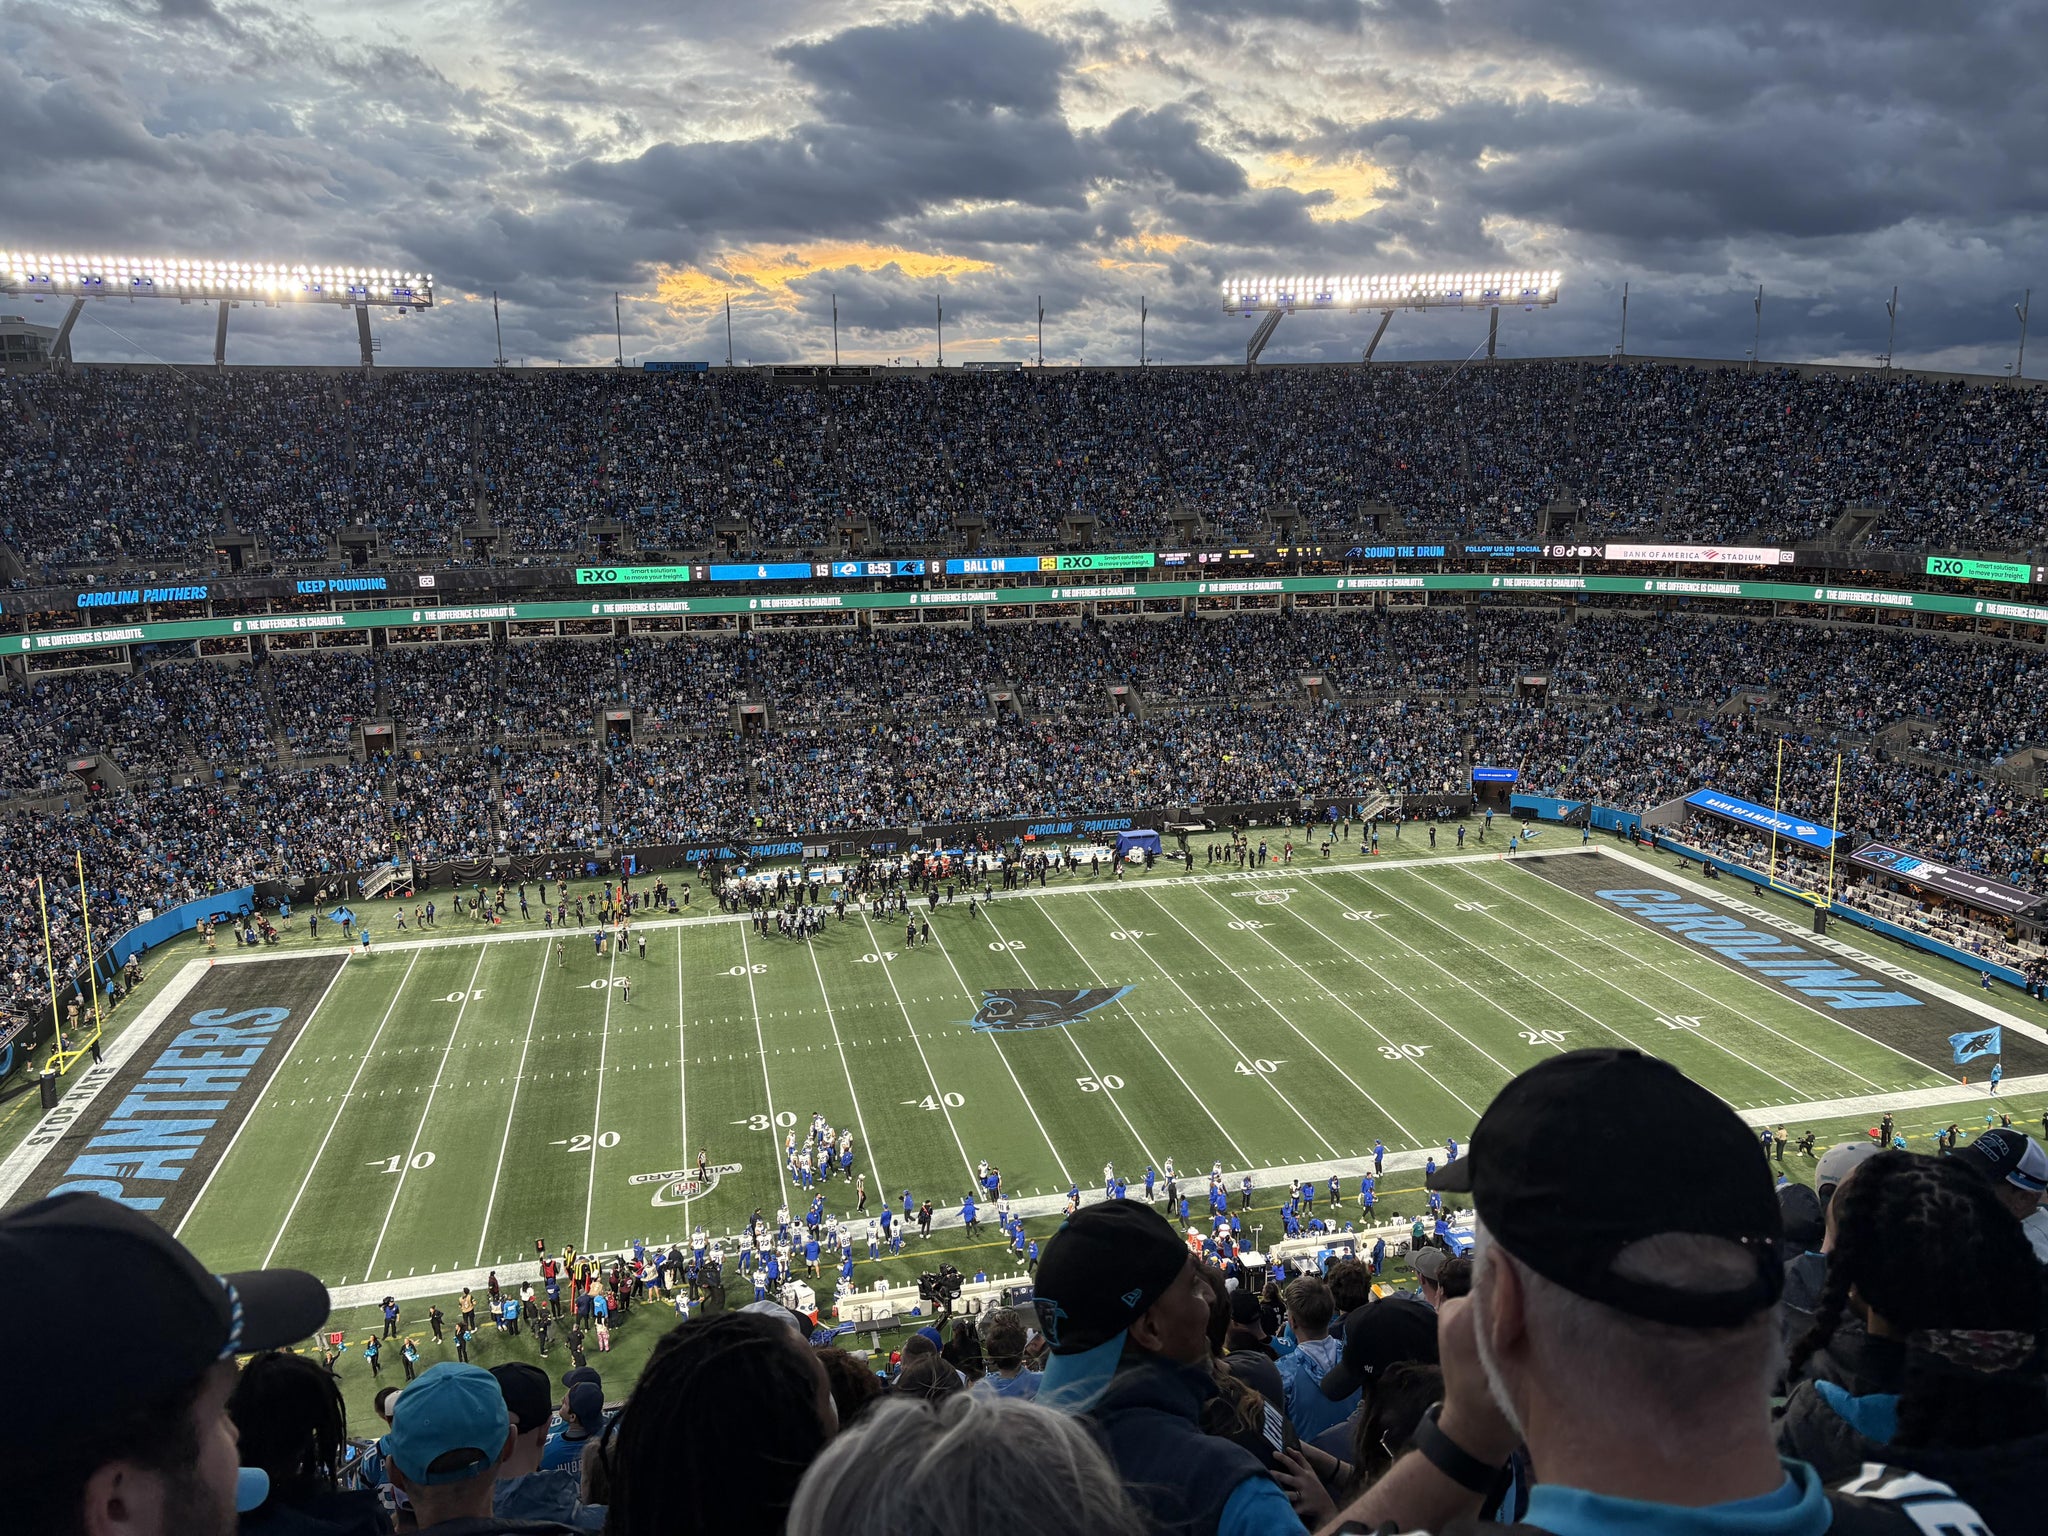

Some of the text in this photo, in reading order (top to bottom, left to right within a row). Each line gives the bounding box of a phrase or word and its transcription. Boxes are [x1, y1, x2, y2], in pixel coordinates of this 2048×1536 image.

[1364, 546, 1444, 558] SOUND THE DRUM
[1721, 553, 1762, 561] STADIUM
[867, 563, 891, 574] 8:53
[931, 561, 939, 573] 6
[964, 560, 1005, 572] BALL ON
[1063, 557, 1092, 568] RXO
[1933, 559, 1963, 574] RXO
[583, 569, 617, 582] RXO
[758, 566, 767, 577] &
[816, 564, 828, 576] 15
[296, 577, 387, 594] KEEP POUNDING
[1209, 581, 1284, 592] THE DIFFERENCE IS CHARLOTTE.
[1347, 578, 1425, 588] THE DIFFERENCE IS CHARLOTTE.
[1503, 578, 1586, 588] THE DIFFERENCE IS CHARLOTTE.
[1656, 582, 1741, 594] THE DIFFERENCE IS CHARLOTTE.
[77, 586, 207, 607] CAROLINA PANTHERS
[920, 592, 998, 603] THE DIFFERENCE IS CHARLOTTE.
[1062, 586, 1136, 598] THE DIFFERENCE IS CHARLOTTE.
[1826, 590, 1913, 606] THE DIFFERENCE IS CHARLOTTE.
[603, 602, 690, 613] THE DIFFERENCE IS CHARLOTTE.
[760, 597, 843, 608] THE DIFFERENCE IS CHARLOTTE.
[424, 607, 517, 620] THE DIFFERENCE IS CHARLOTTE.
[1986, 603, 2035, 618] THE DIFFERENCE IS
[246, 615, 346, 630] THE DIFFERENCE IS CHARLOTTE.
[36, 628, 144, 648] THE DIFFERENCE IS CHARLOTTE.
[1705, 799, 1792, 831] BANK OF AMERICA
[1027, 818, 1132, 836] CAROLINA PANTHERS
[751, 842, 803, 857] PANTHERS
[1453, 901, 1488, 912] 10
[1342, 910, 1380, 921] 20
[1227, 919, 1265, 930] 30
[1110, 929, 1145, 941] 40
[1711, 895, 1918, 981] IT TAKES ALL OF US
[988, 940, 1027, 951] 50
[1594, 889, 1926, 1009] CAROLINA
[862, 951, 899, 963] 40
[729, 963, 768, 976] 30
[446, 989, 487, 1003] 10
[1654, 1014, 1702, 1031] 10
[1518, 1029, 1566, 1046] 20
[1377, 1043, 1425, 1060] 30
[1234, 1058, 1278, 1076] 40
[1076, 1074, 1125, 1093] 50
[26, 1064, 116, 1146] STOP HATE
[919, 1091, 966, 1111] 40
[46, 1006, 291, 1211] PANTHERS
[748, 1111, 798, 1131] 30
[567, 1131, 621, 1153] 20
[381, 1151, 436, 1173] 10
[636, 1171, 685, 1182] CARD
